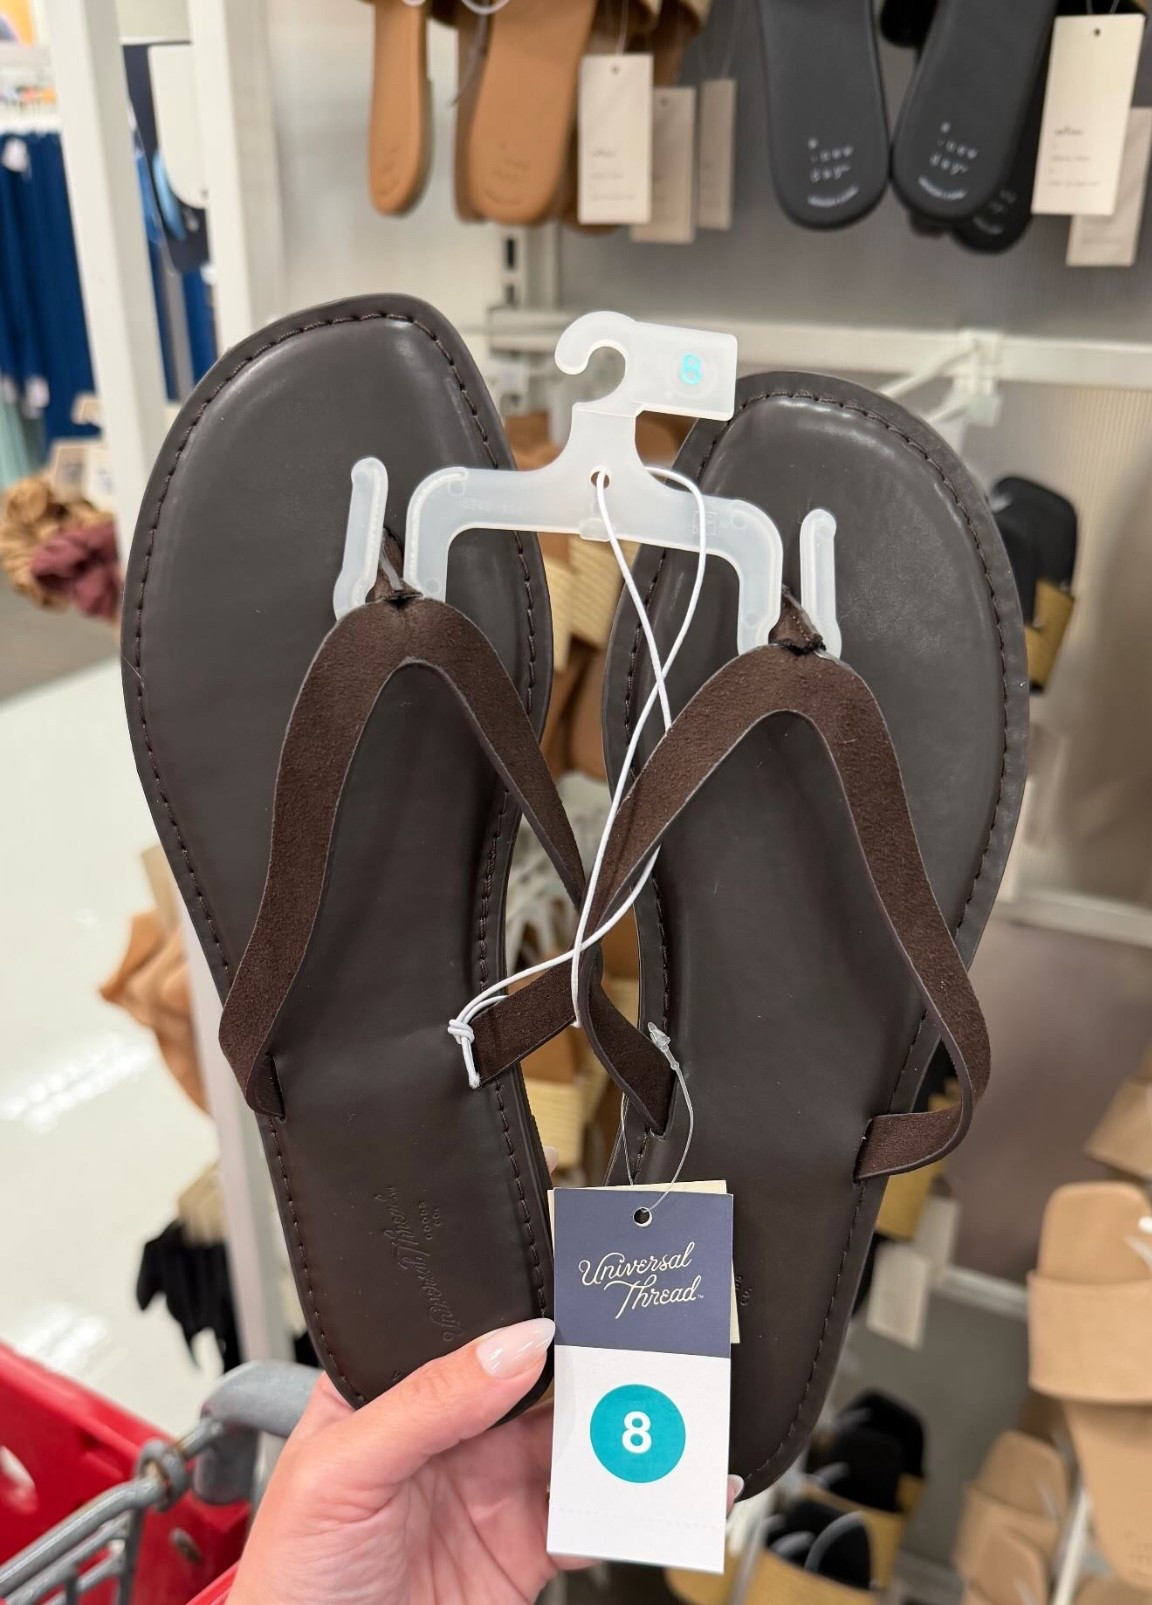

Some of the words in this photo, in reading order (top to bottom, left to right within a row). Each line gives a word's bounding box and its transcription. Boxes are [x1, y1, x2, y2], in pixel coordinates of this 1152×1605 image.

[680, 352, 702, 384] 8
[579, 1241, 695, 1286] Universal
[603, 1274, 702, 1319] Thread
[621, 1410, 652, 1454] 8
